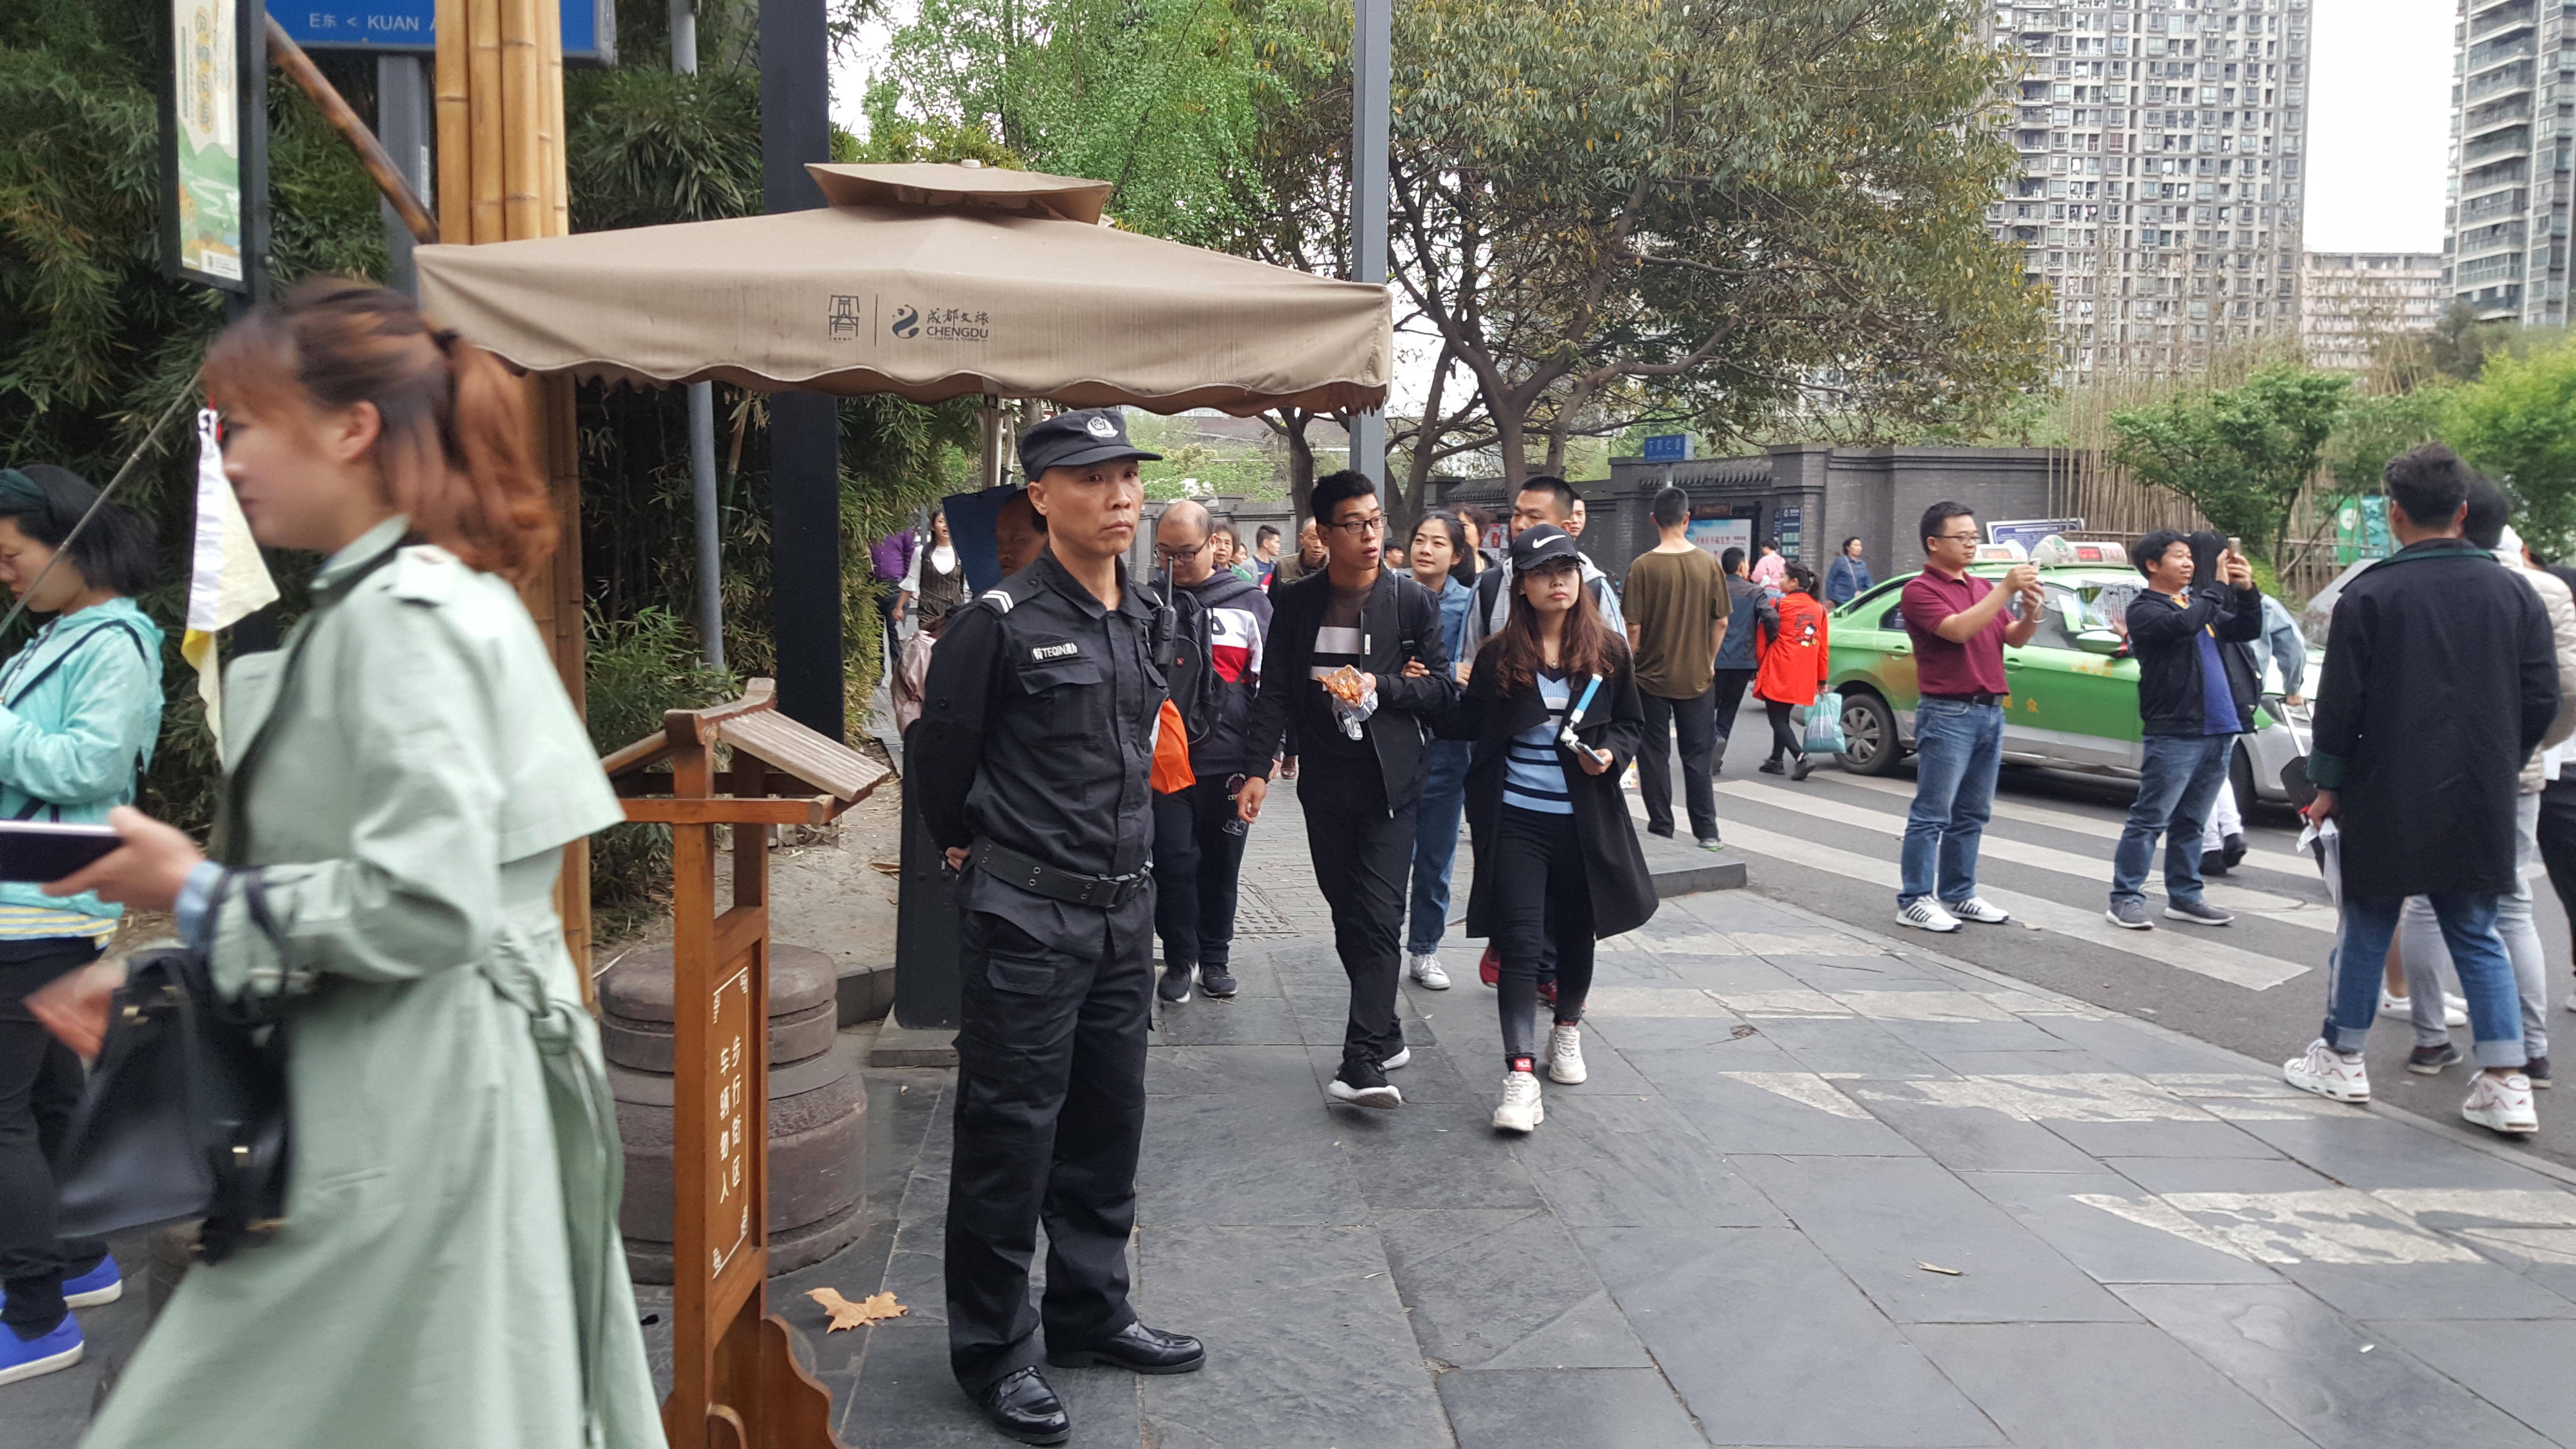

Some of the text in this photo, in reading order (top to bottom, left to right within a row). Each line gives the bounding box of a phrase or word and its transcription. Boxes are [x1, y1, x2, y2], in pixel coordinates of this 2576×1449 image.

[368, 15, 419, 31] KUAN
[927, 307, 989, 326] 成都文旅
[926, 326, 988, 338] CHENGDU
